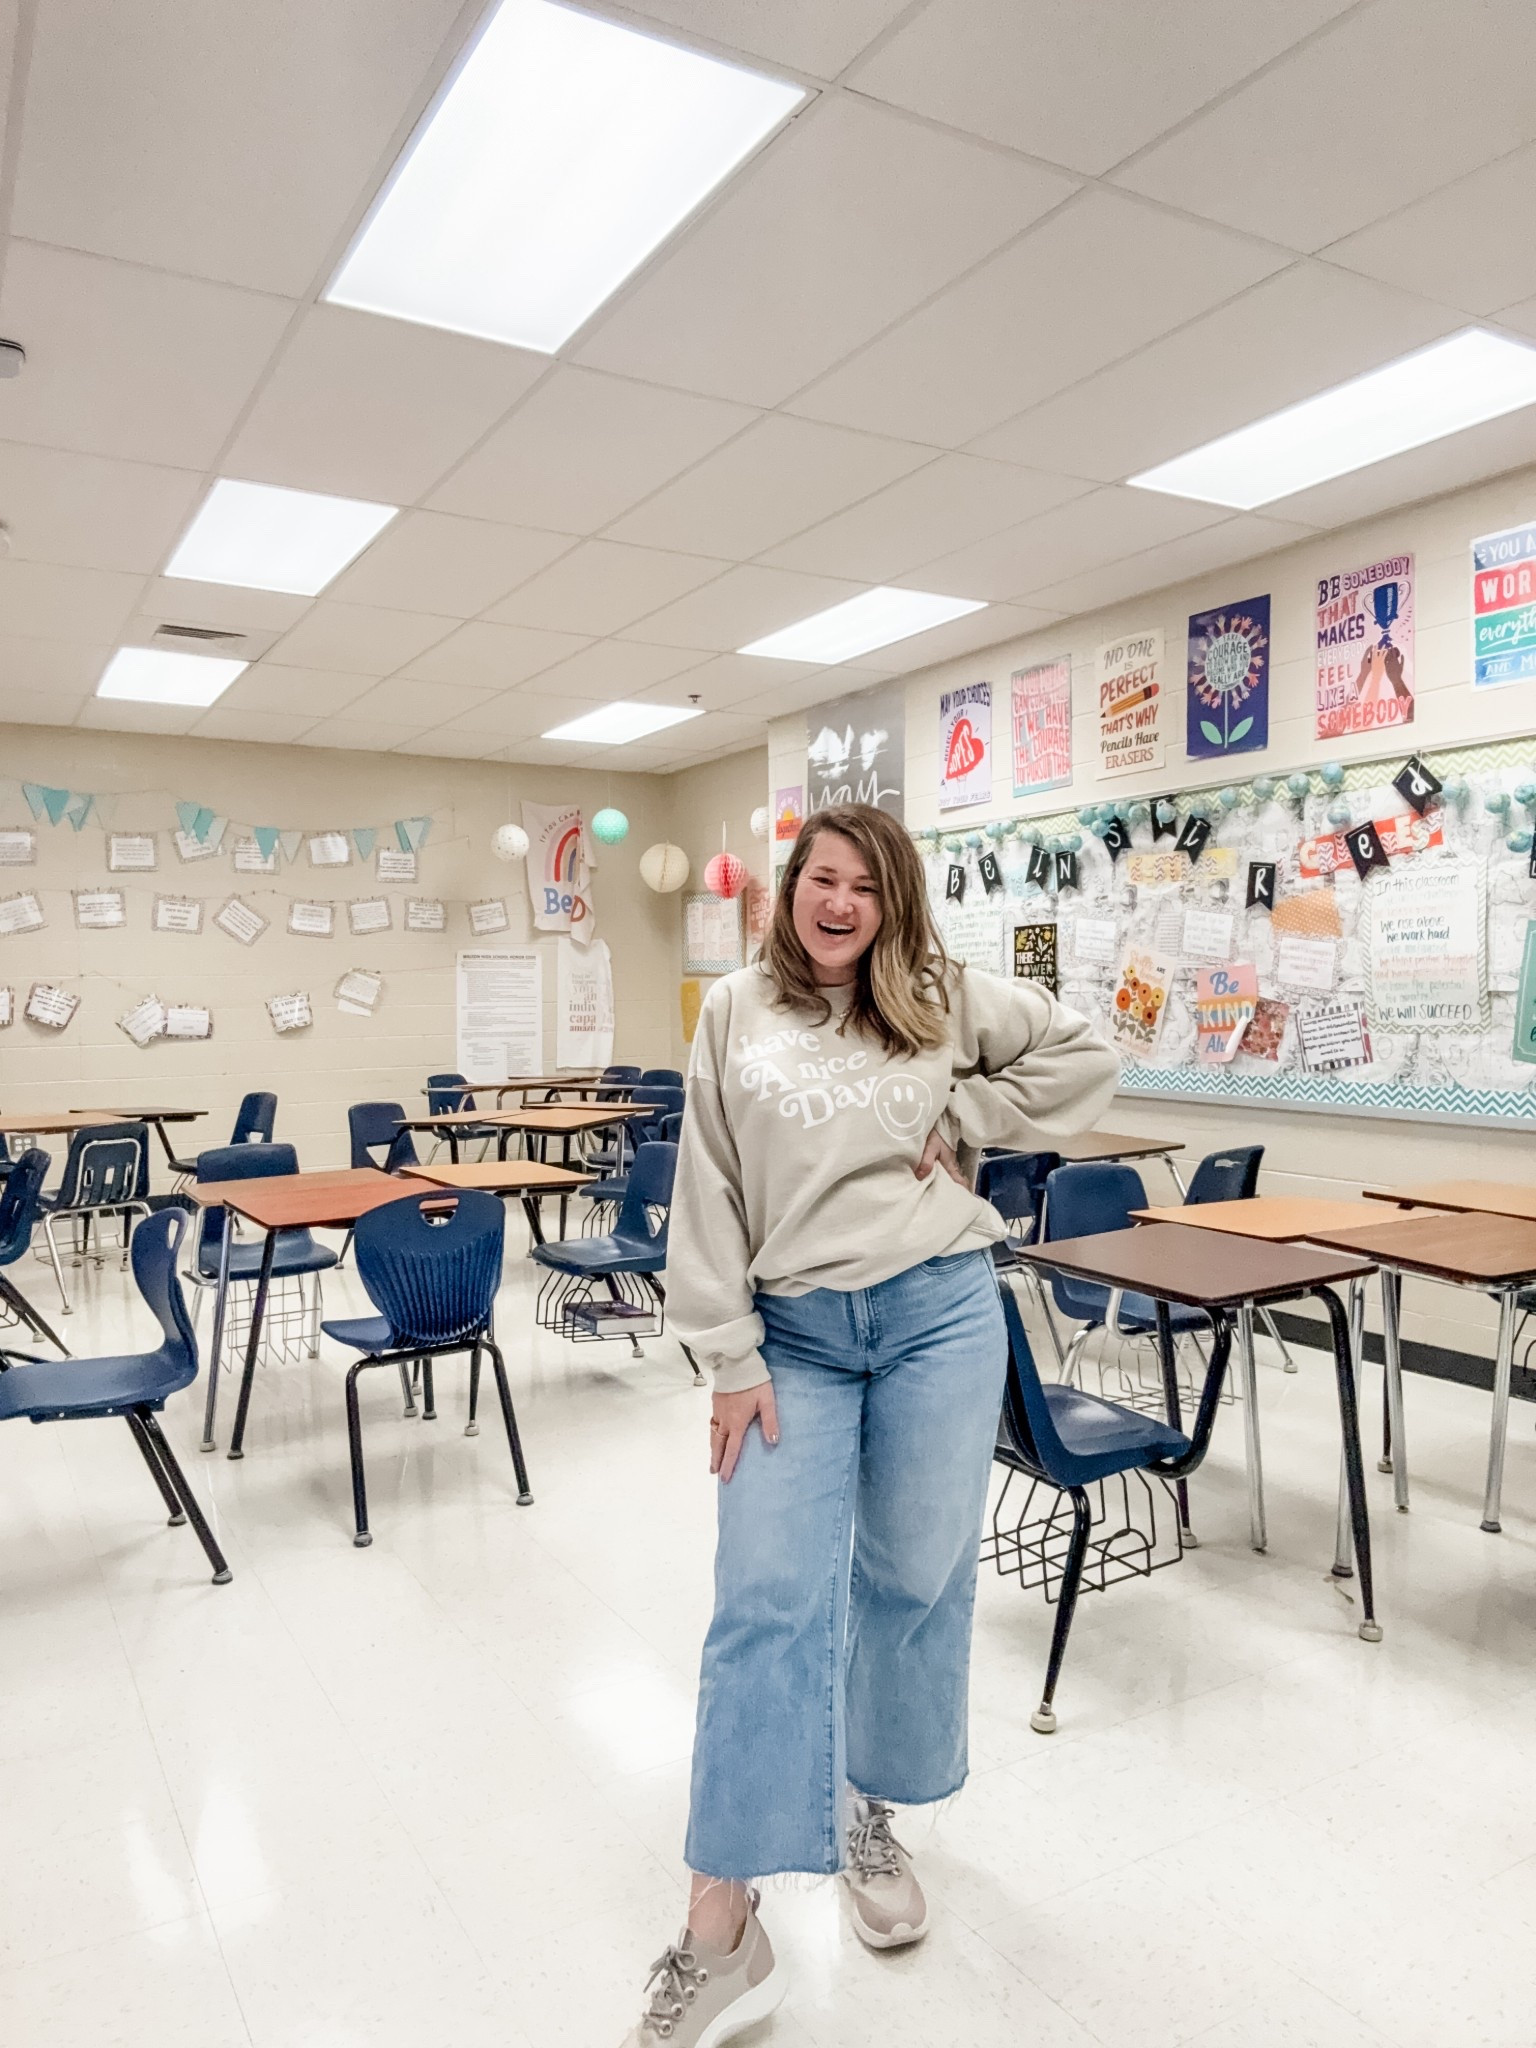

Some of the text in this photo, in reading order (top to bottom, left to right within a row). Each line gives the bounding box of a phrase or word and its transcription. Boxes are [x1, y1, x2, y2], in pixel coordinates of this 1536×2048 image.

[1489, 537, 1520, 563] YOU
[1317, 556, 1410, 607] BE SOMEBODY
[1317, 590, 1359, 629] THAT
[1317, 613, 1365, 649] MAKES
[1103, 637, 1155, 670] NO ONE
[1207, 641, 1248, 661] COURAGE
[1100, 661, 1158, 708] PERFECT
[1317, 664, 1353, 688] FEEL
[1316, 681, 1359, 712] LIKE A
[1044, 702, 1069, 730] HAVE
[1100, 703, 1159, 736] THAT'S WHY
[1316, 695, 1413, 736] SOMEBODY
[1031, 728, 1069, 761] COURAGE
[1101, 731, 1160, 754] Pencils Have
[1105, 747, 1154, 770] ERASERS
[1375, 879, 1391, 896] In
[1393, 876, 1413, 892] this
[1414, 873, 1458, 890] classroom
[543, 887, 573, 915] Be
[1401, 929, 1425, 941] work
[1427, 926, 1450, 941] hard
[1015, 950, 1035, 965] THERE
[1015, 963, 1053, 977] POWER
[1209, 971, 1239, 996] Be
[1201, 1000, 1253, 1029] KIND
[1418, 1003, 1473, 1021] SUCCEED
[739, 1029, 822, 1062] have
[739, 1050, 868, 1102] A nice
[778, 1075, 879, 1130] Day
